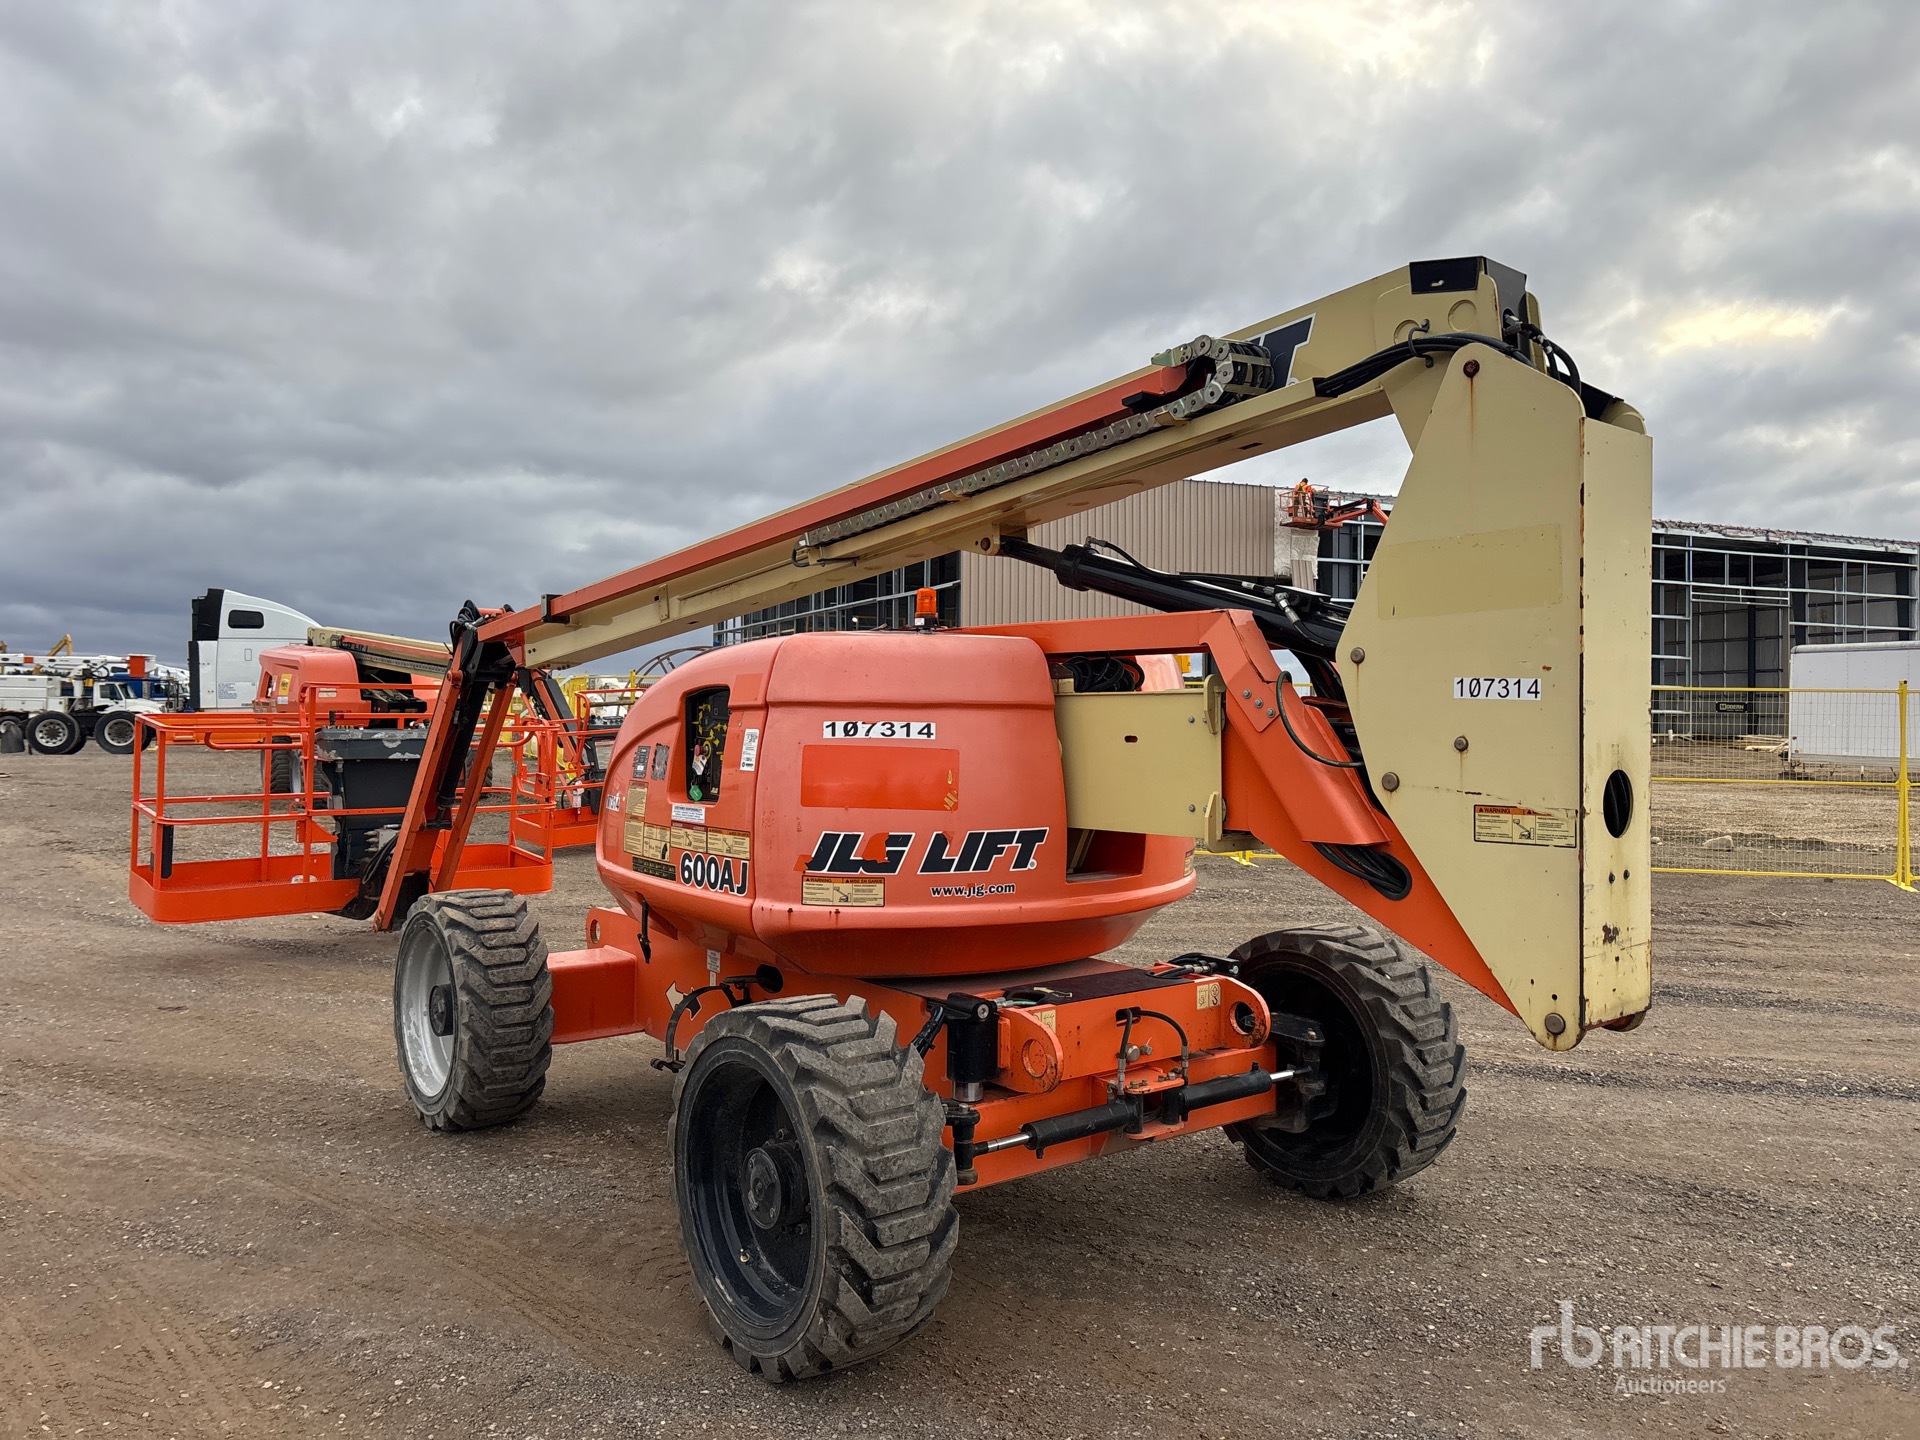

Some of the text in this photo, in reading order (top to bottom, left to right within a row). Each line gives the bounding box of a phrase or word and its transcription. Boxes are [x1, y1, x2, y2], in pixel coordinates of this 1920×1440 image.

[1456, 677, 1541, 699] 107314
[825, 721, 935, 739] 107314
[804, 831, 916, 875] JLG
[917, 827, 1050, 875] LIFT
[680, 850, 749, 897] 600AJ
[931, 883, 1015, 897] www.jlg.com
